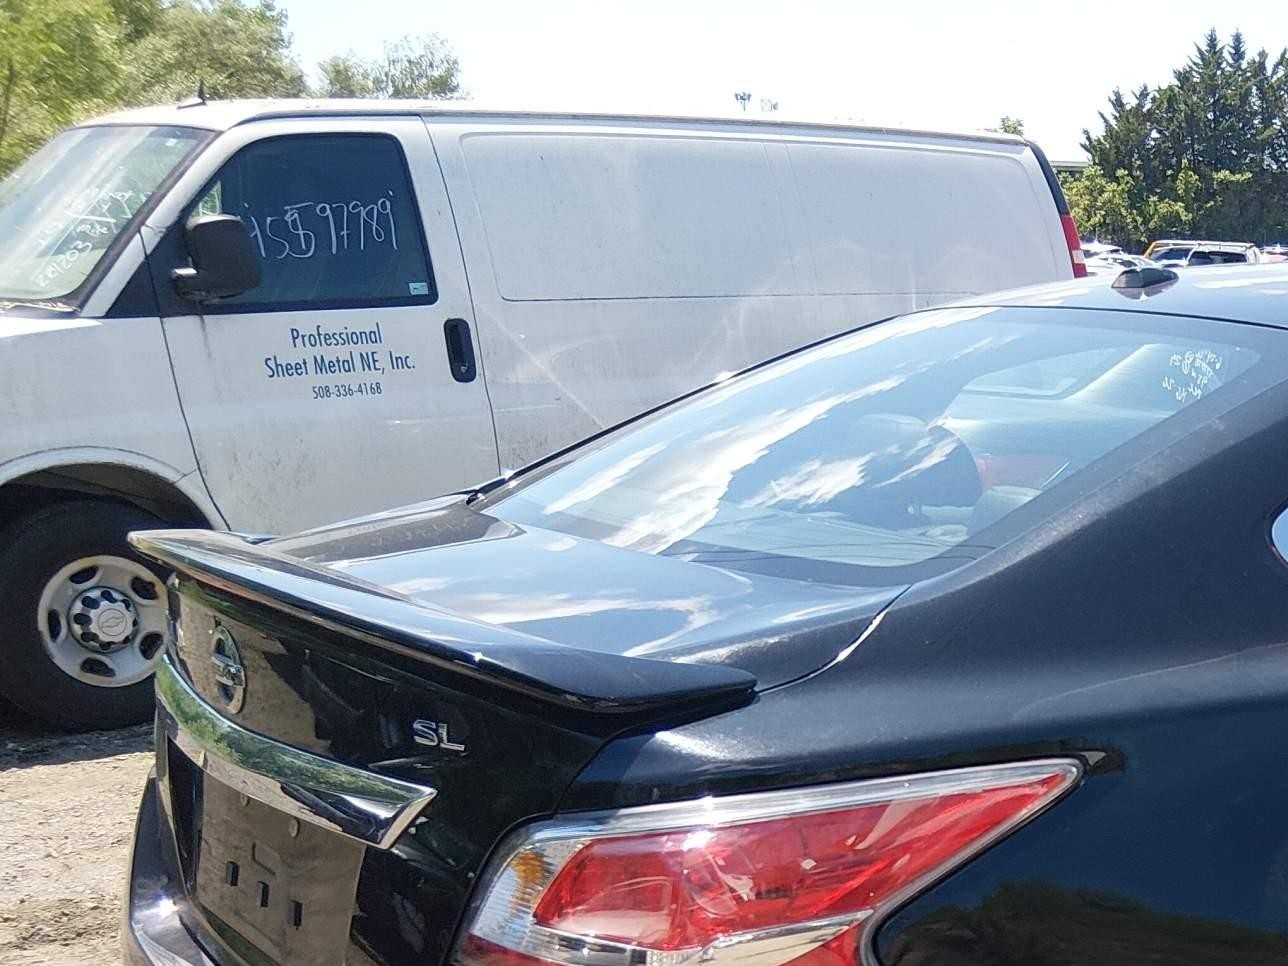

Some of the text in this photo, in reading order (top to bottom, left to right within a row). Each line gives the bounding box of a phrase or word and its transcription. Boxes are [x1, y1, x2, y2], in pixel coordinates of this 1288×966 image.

[290, 322, 382, 348] Professional
[264, 350, 416, 378] Sheet Metal NE, Inc.
[312, 381, 382, 400] 508-336-4168
[413, 719, 465, 751] SL
